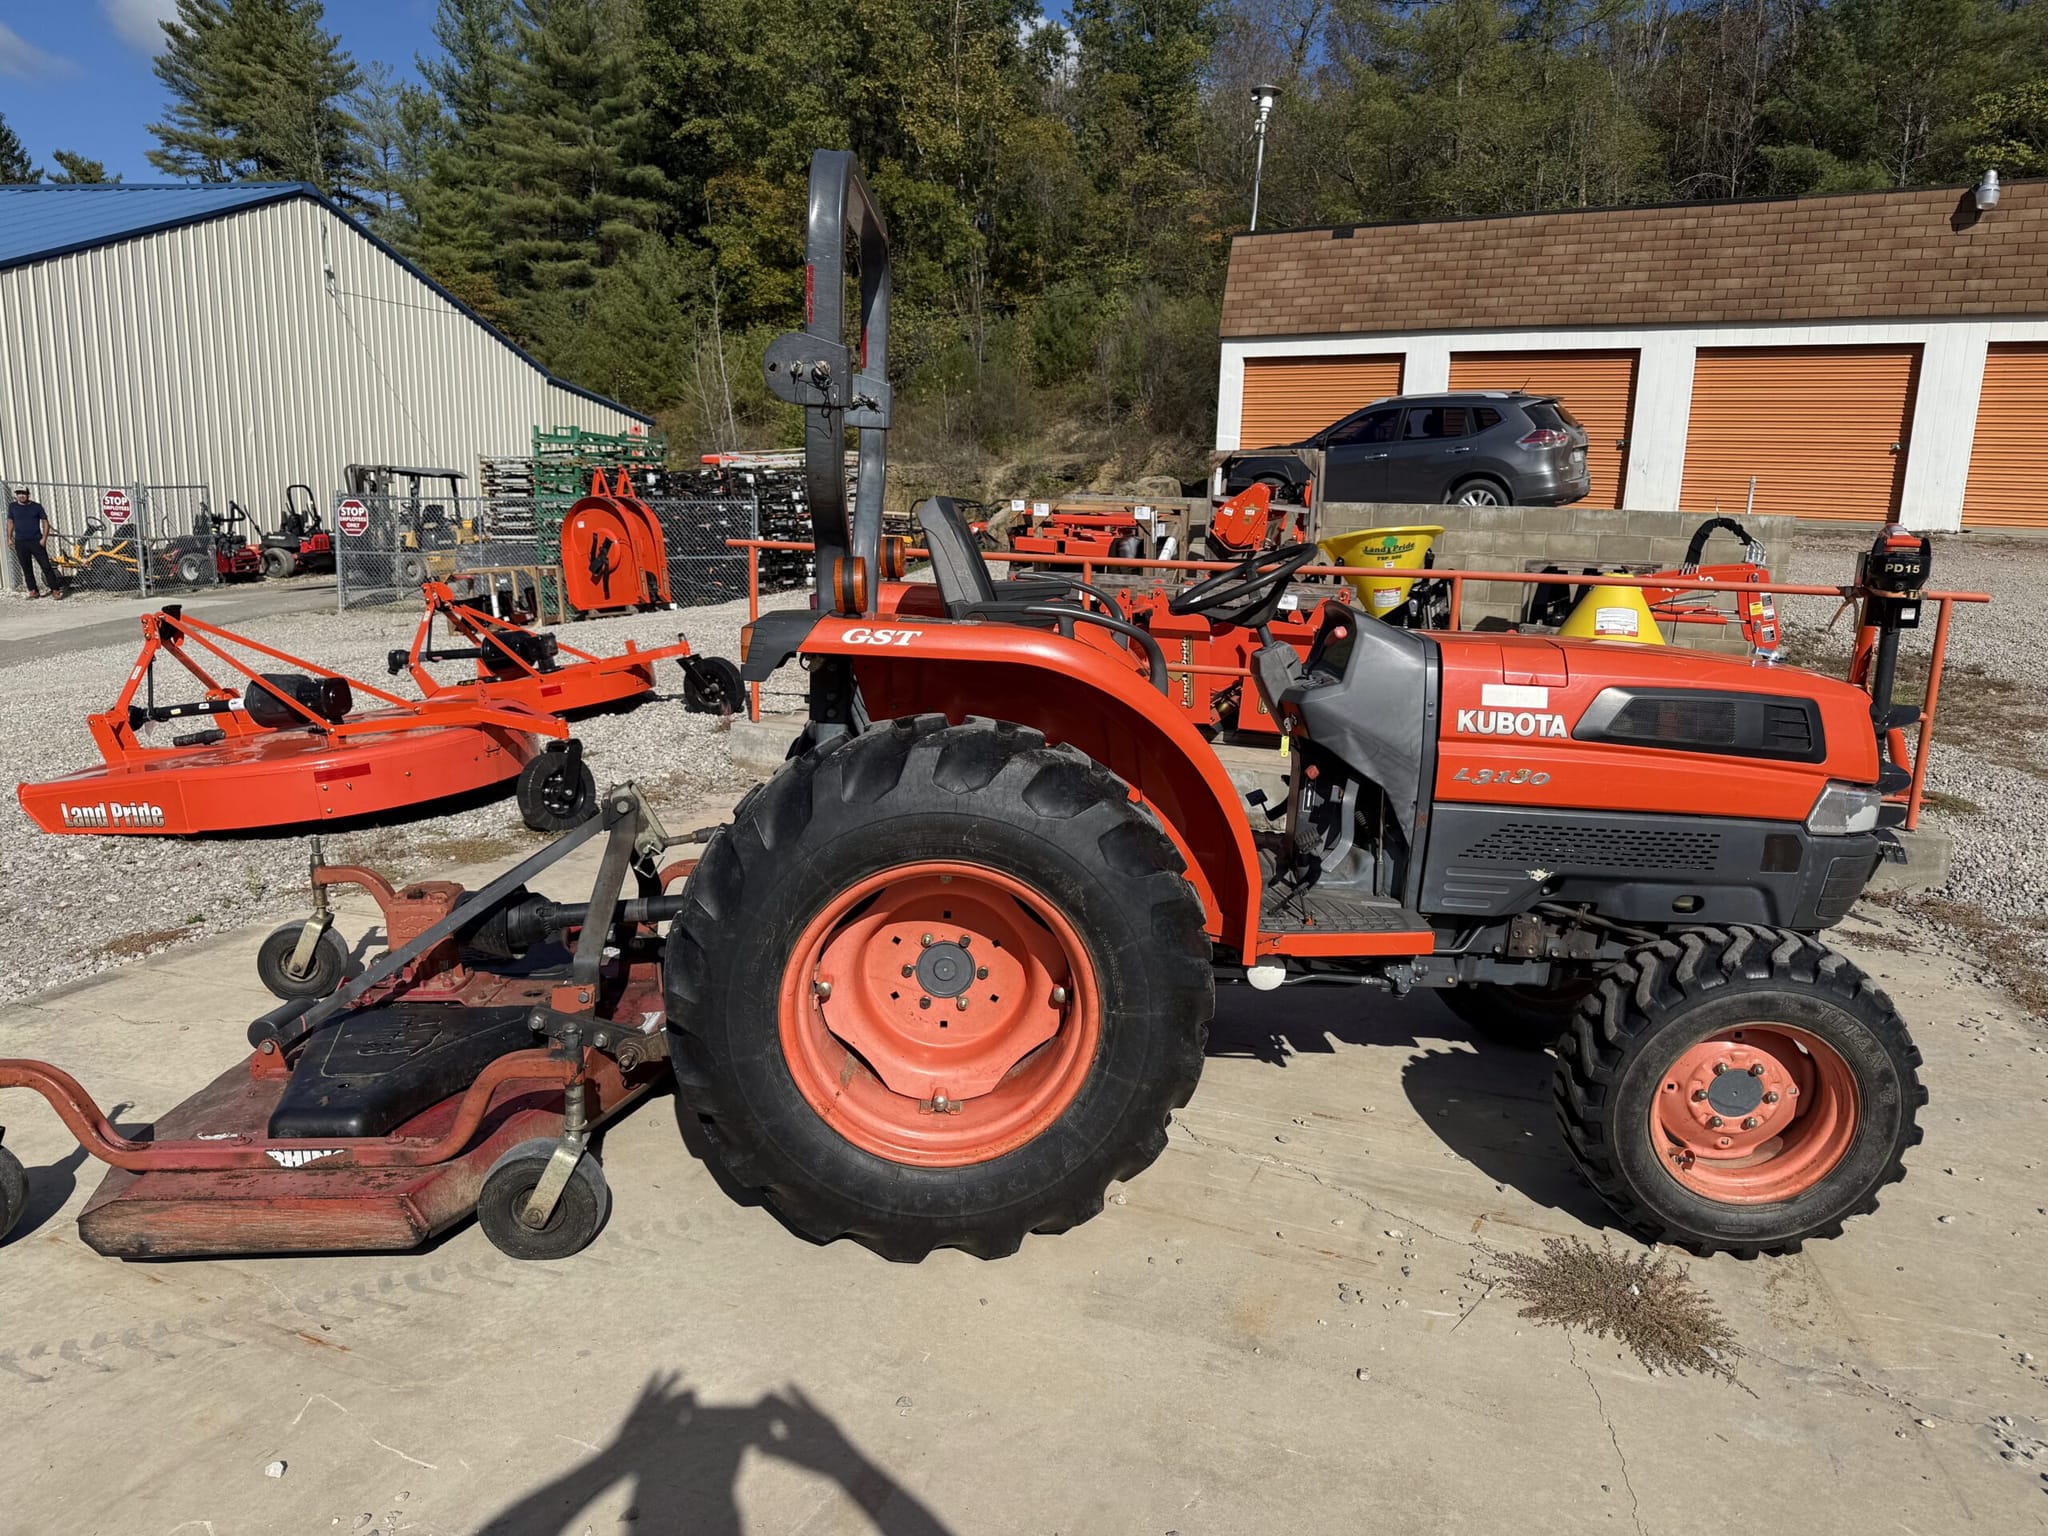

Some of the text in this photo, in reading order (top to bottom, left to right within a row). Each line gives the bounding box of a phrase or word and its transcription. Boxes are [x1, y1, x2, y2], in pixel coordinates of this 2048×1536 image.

[104, 496, 127, 505] STOP
[341, 507, 364, 516] STOP
[1392, 541, 1415, 551] Pride
[1884, 563, 1920, 574] PD15
[841, 627, 923, 646] GST
[1456, 709, 1569, 738] KUBOTA
[1452, 767, 1551, 785] L3130
[60, 801, 165, 828] Land Pride
[1816, 1004, 1891, 1071] TITAN
[265, 1149, 345, 1168] RHIN
